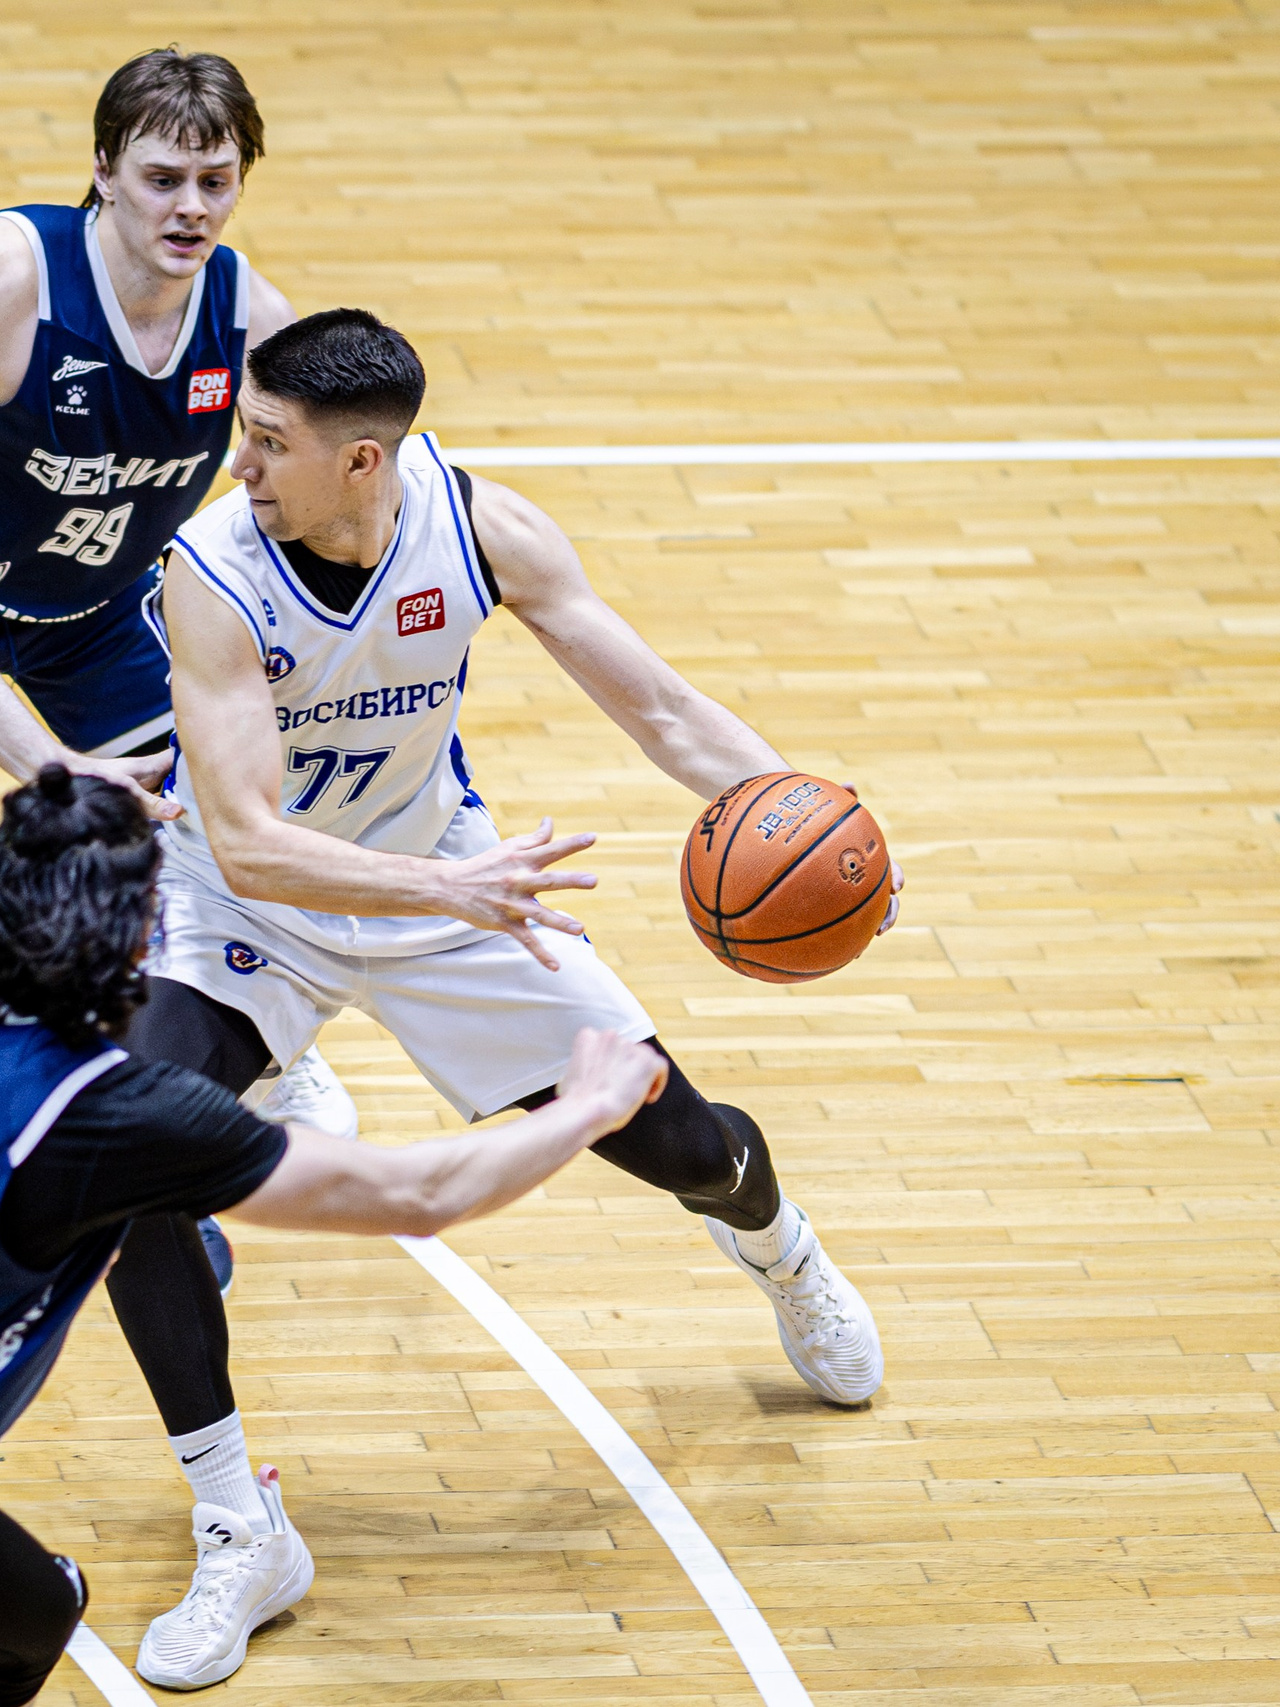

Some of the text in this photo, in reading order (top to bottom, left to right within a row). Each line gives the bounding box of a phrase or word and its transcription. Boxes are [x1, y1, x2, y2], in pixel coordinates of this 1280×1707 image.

[189, 373, 228, 392] FON
[55, 404, 90, 416] KELME
[188, 389, 228, 409] BET
[25, 448, 209, 495] ЗЕНИТ
[37, 502, 134, 566] 99
[400, 593, 440, 615] FON
[401, 608, 441, 631] BET
[287, 745, 396, 815] 77
[756, 781, 822, 841] JB-1000
